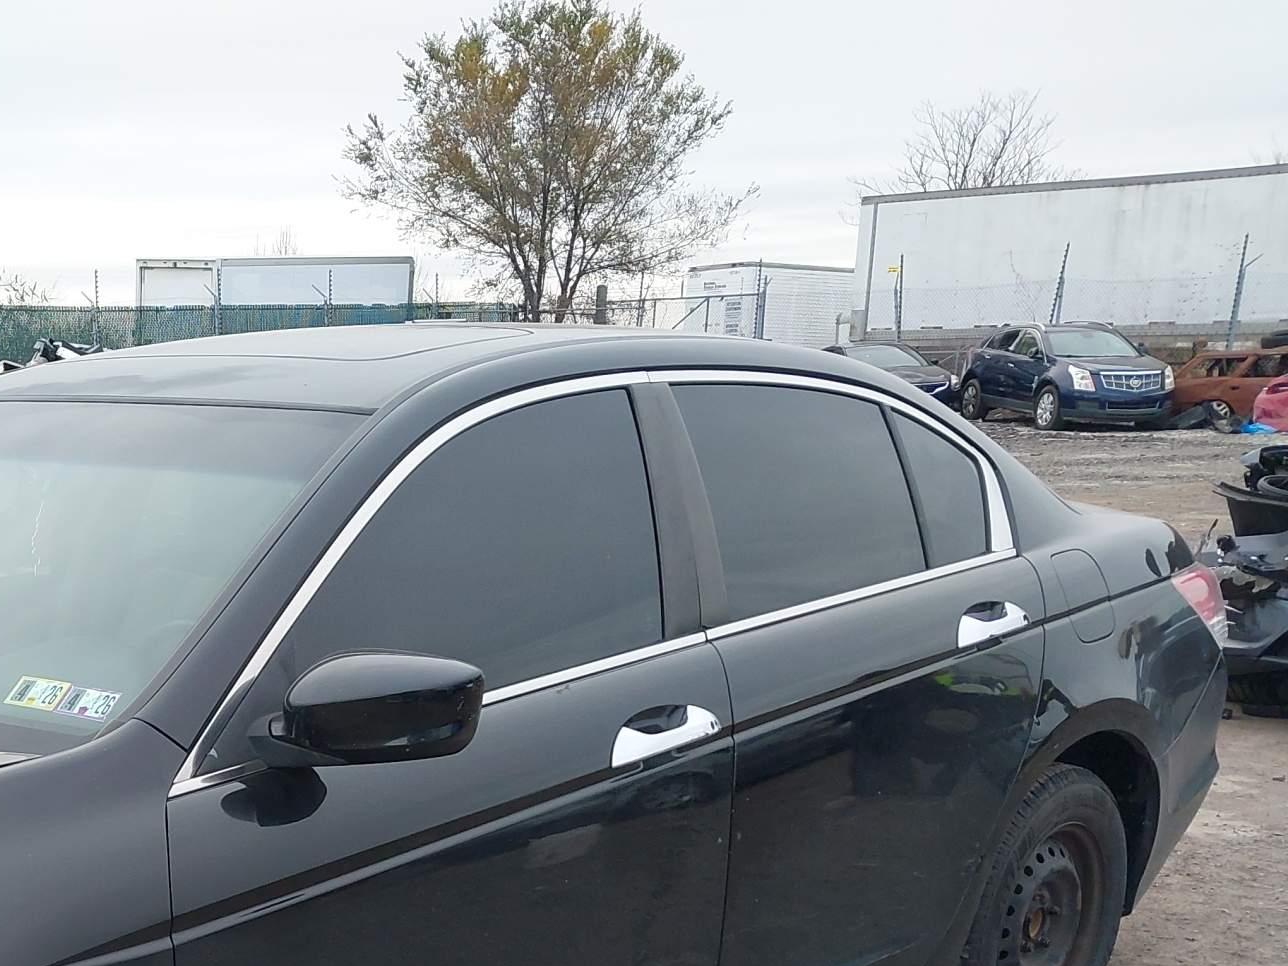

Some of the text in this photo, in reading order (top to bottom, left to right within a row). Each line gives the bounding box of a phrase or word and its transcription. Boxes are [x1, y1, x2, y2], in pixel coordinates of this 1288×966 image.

[15, 684, 63, 705] 4 26
[65, 693, 116, 715] 4 26
